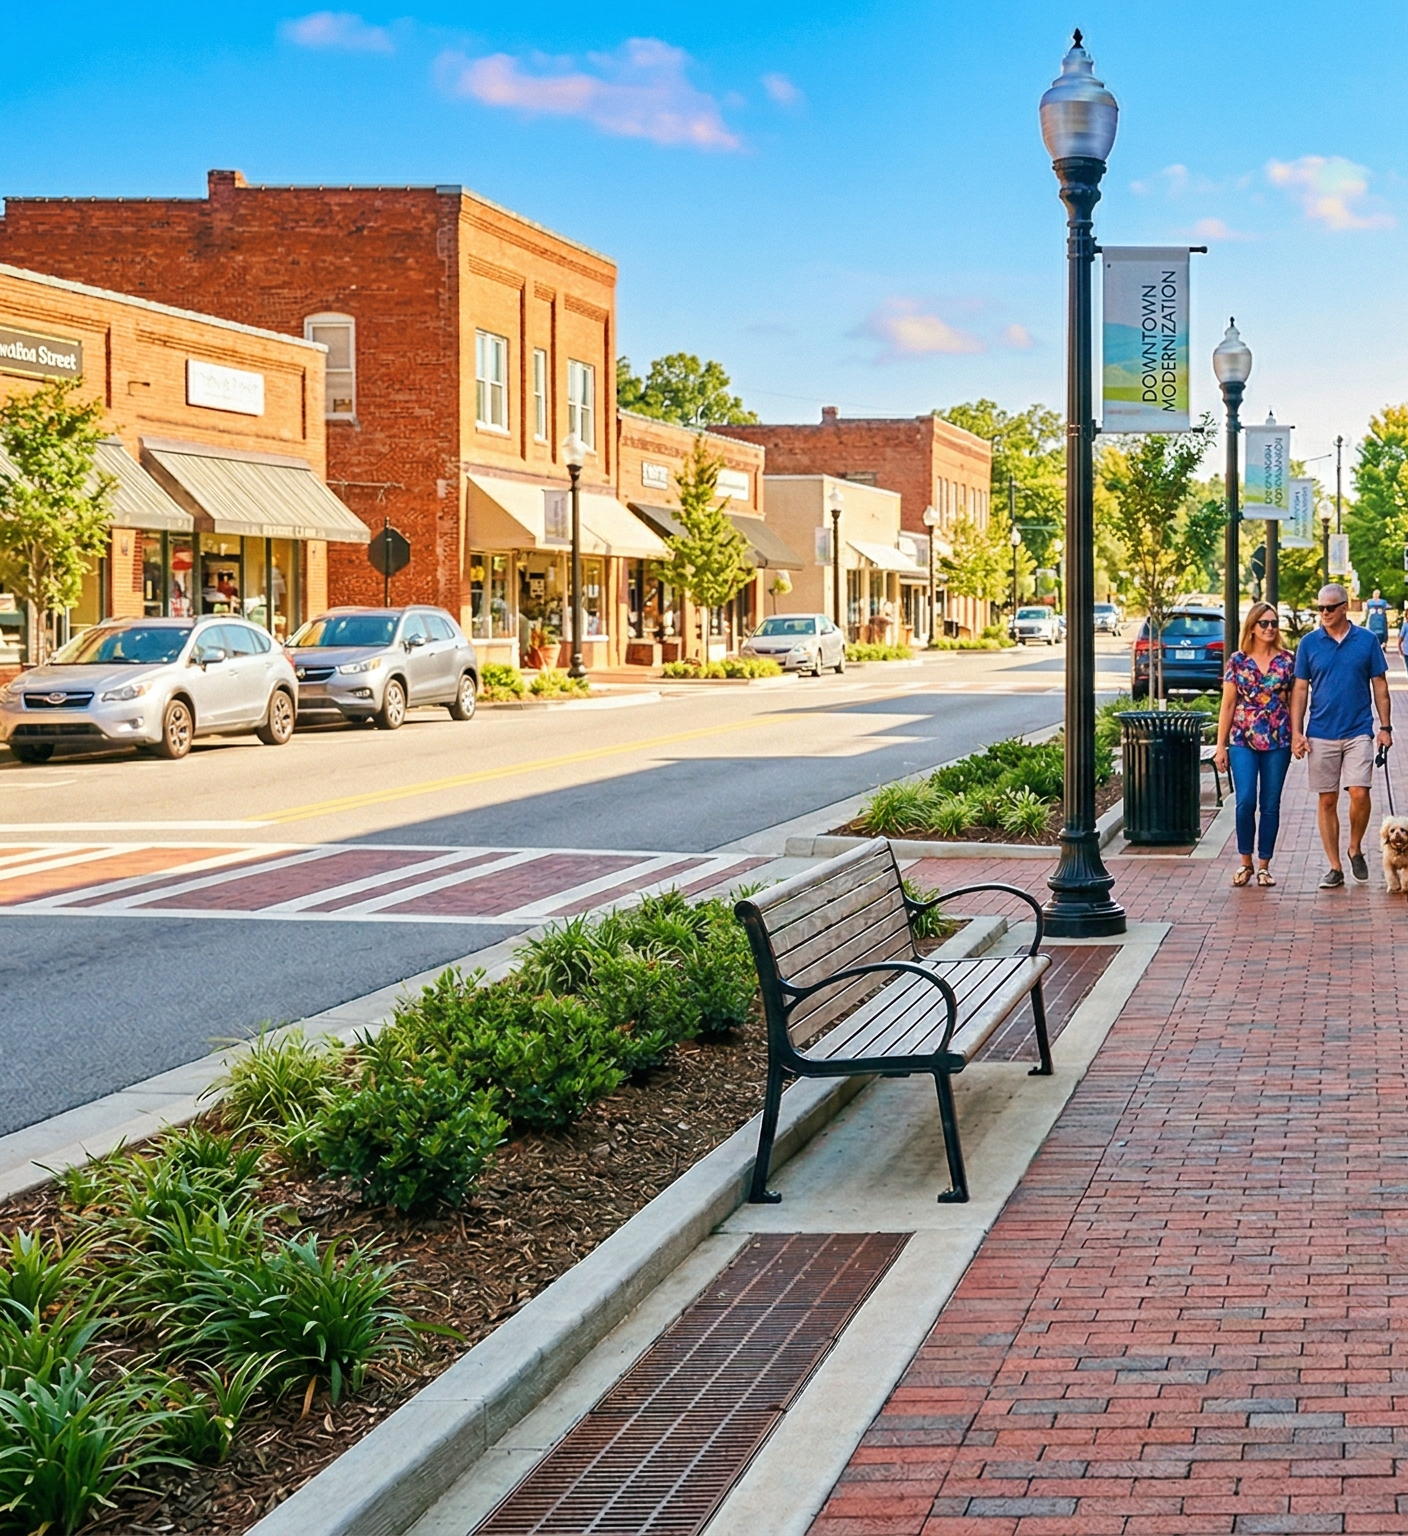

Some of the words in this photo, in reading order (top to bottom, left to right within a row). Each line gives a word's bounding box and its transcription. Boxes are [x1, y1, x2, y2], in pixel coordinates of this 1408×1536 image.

[38, 345, 77, 371] Street
[1142, 285, 1158, 402] DOWNTOWN
[1161, 271, 1177, 412] MODERNIZATION
